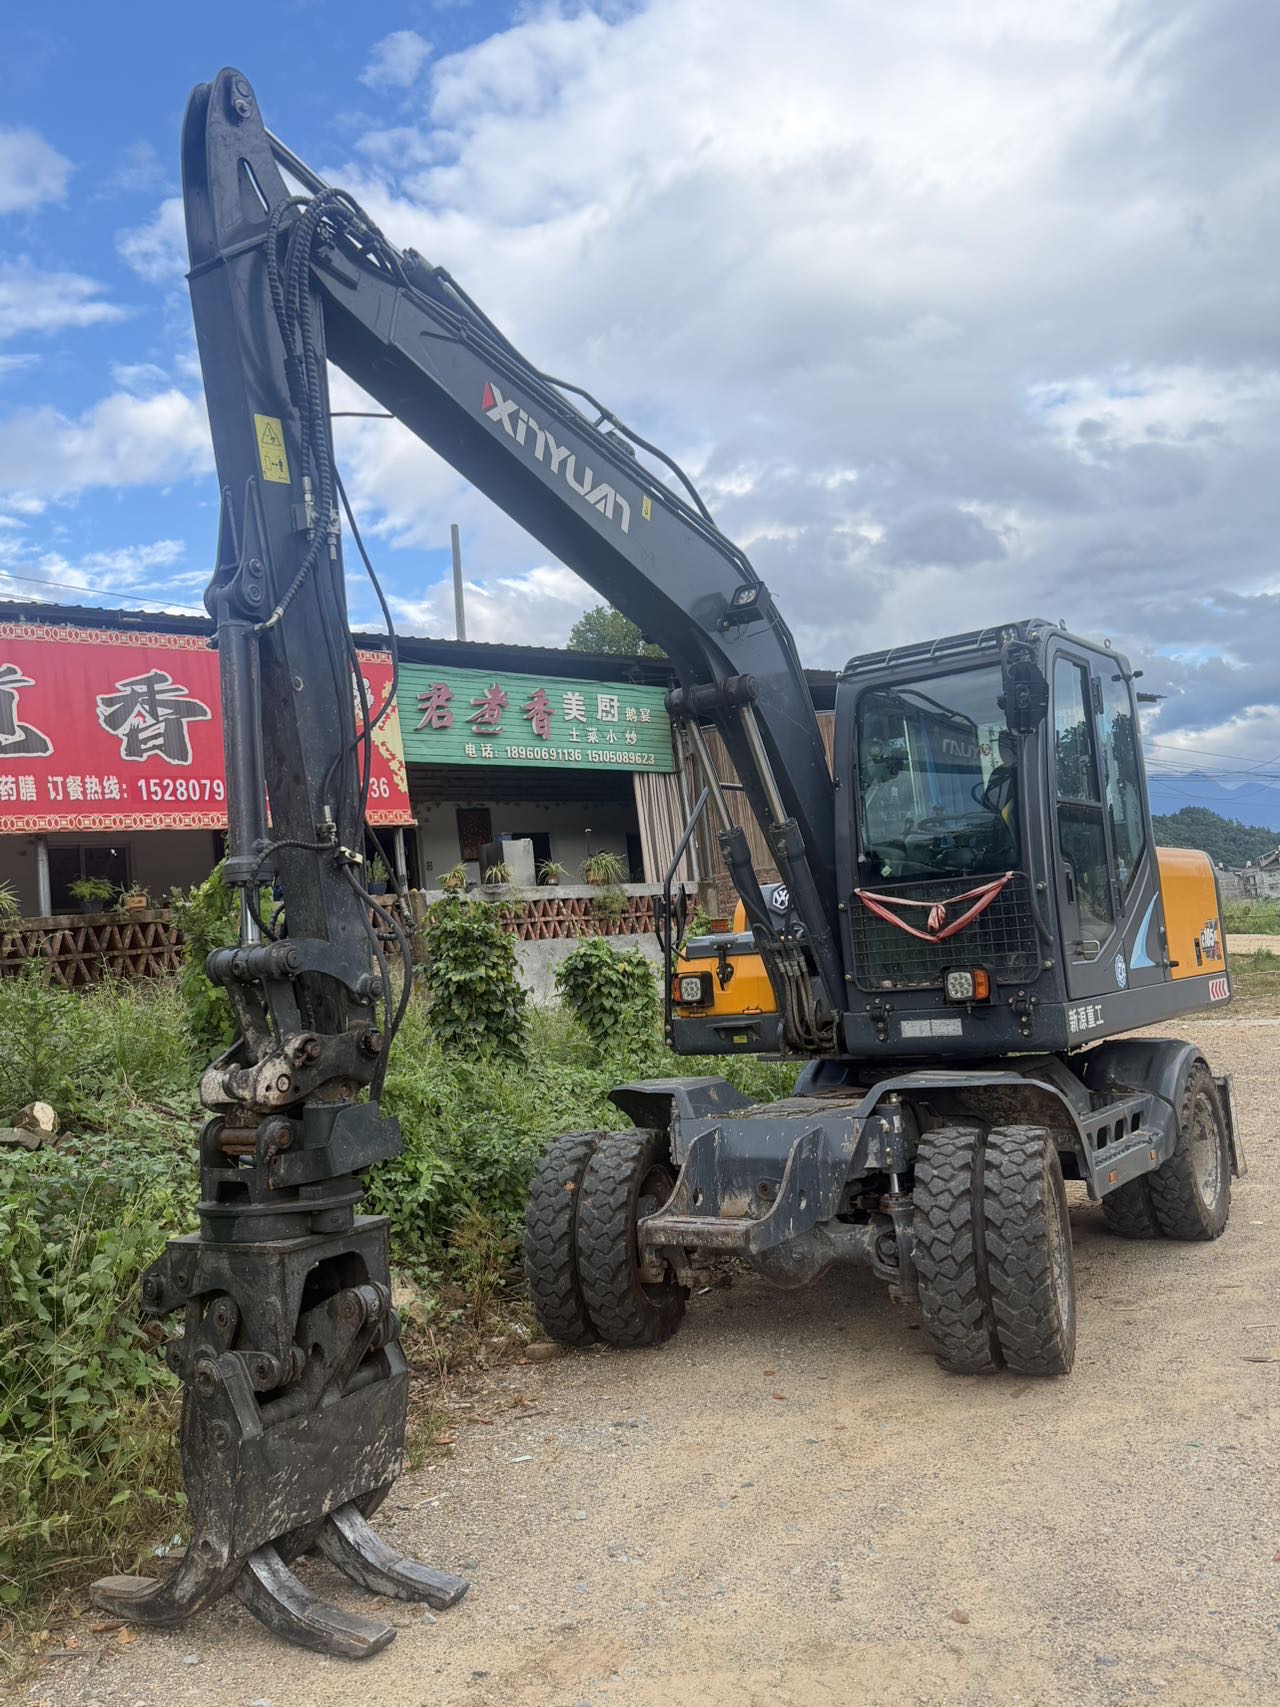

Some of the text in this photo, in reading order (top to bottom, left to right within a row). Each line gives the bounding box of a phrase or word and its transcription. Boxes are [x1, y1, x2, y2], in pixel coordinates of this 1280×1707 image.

[505, 746, 582, 761] 18960691136
[587, 750, 655, 765] 15105089623
[137, 777, 225, 801] 1528079
[1068, 1004, 1104, 1033] 新源重工
